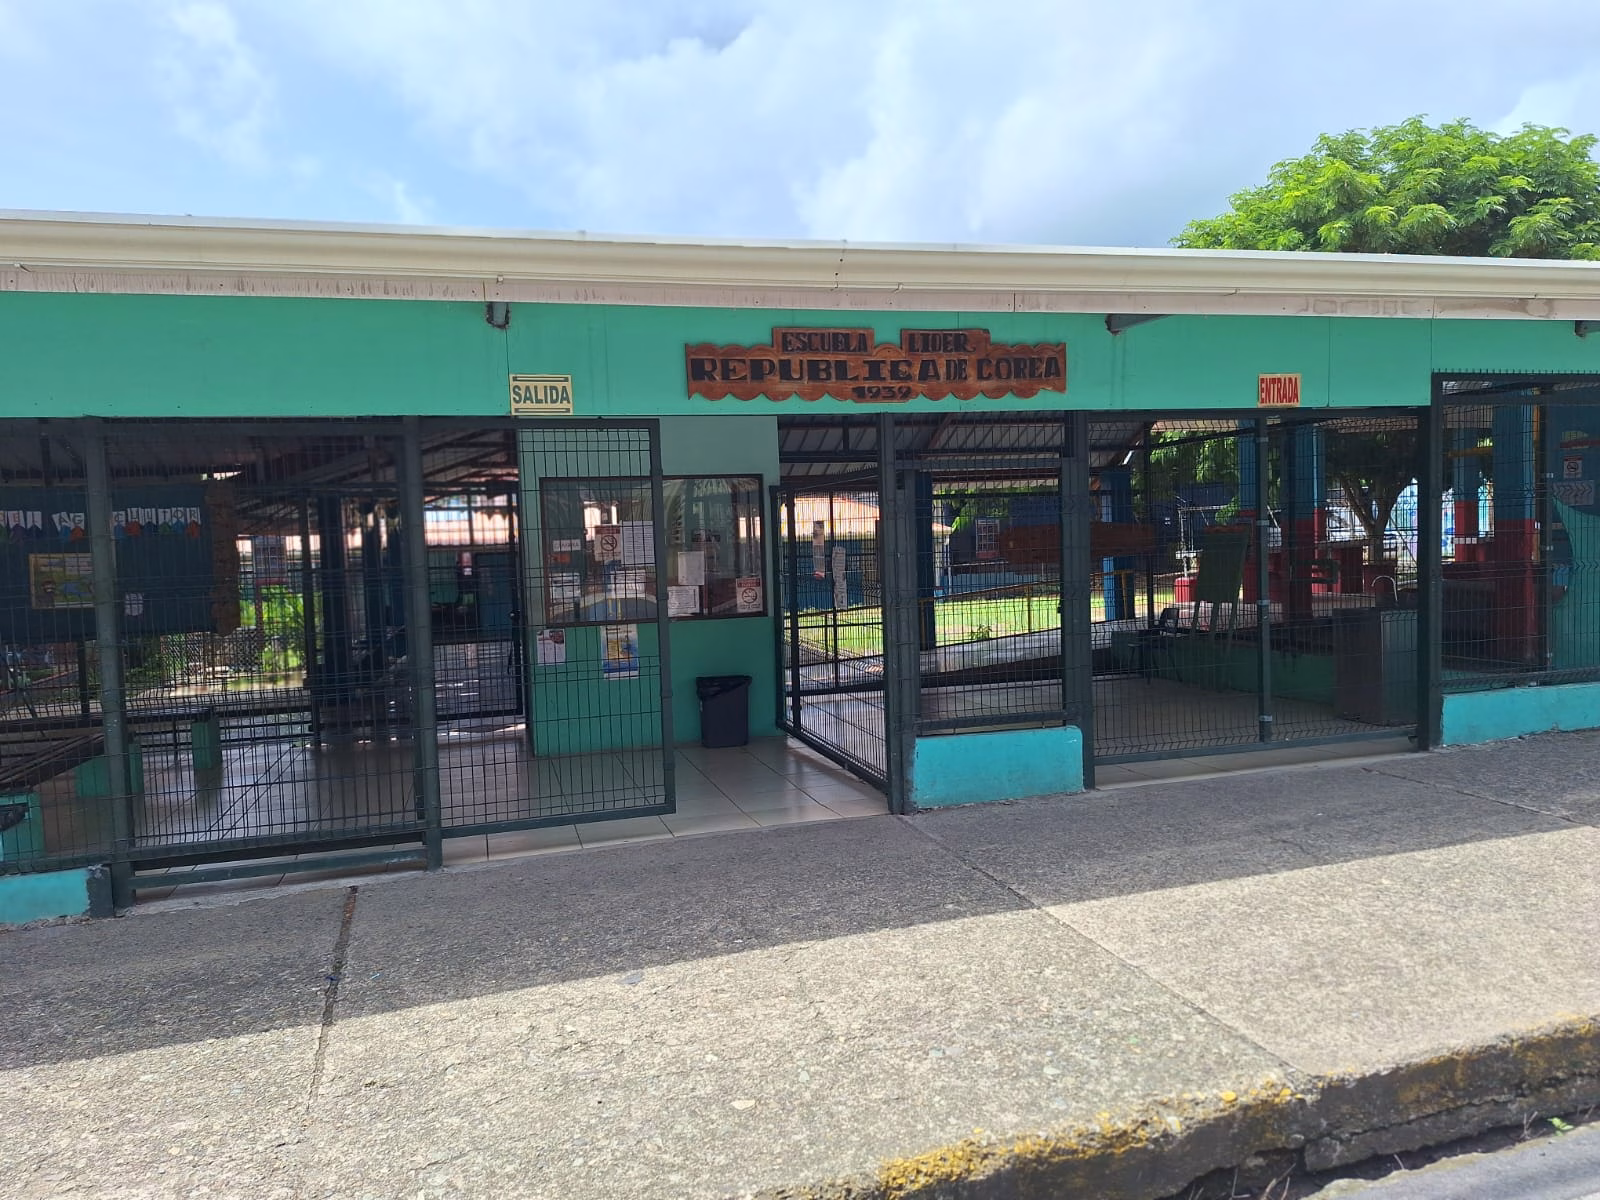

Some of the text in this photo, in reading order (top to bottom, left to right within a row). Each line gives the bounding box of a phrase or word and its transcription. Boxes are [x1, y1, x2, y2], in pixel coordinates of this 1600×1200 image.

[781, 332, 976, 353] ESCUELA LIDER
[690, 357, 1060, 382] REPUBLICA DE COREA
[512, 385, 571, 404] SALIDA
[851, 386, 912, 399] 1939
[1260, 377, 1298, 404] ENTRADA
